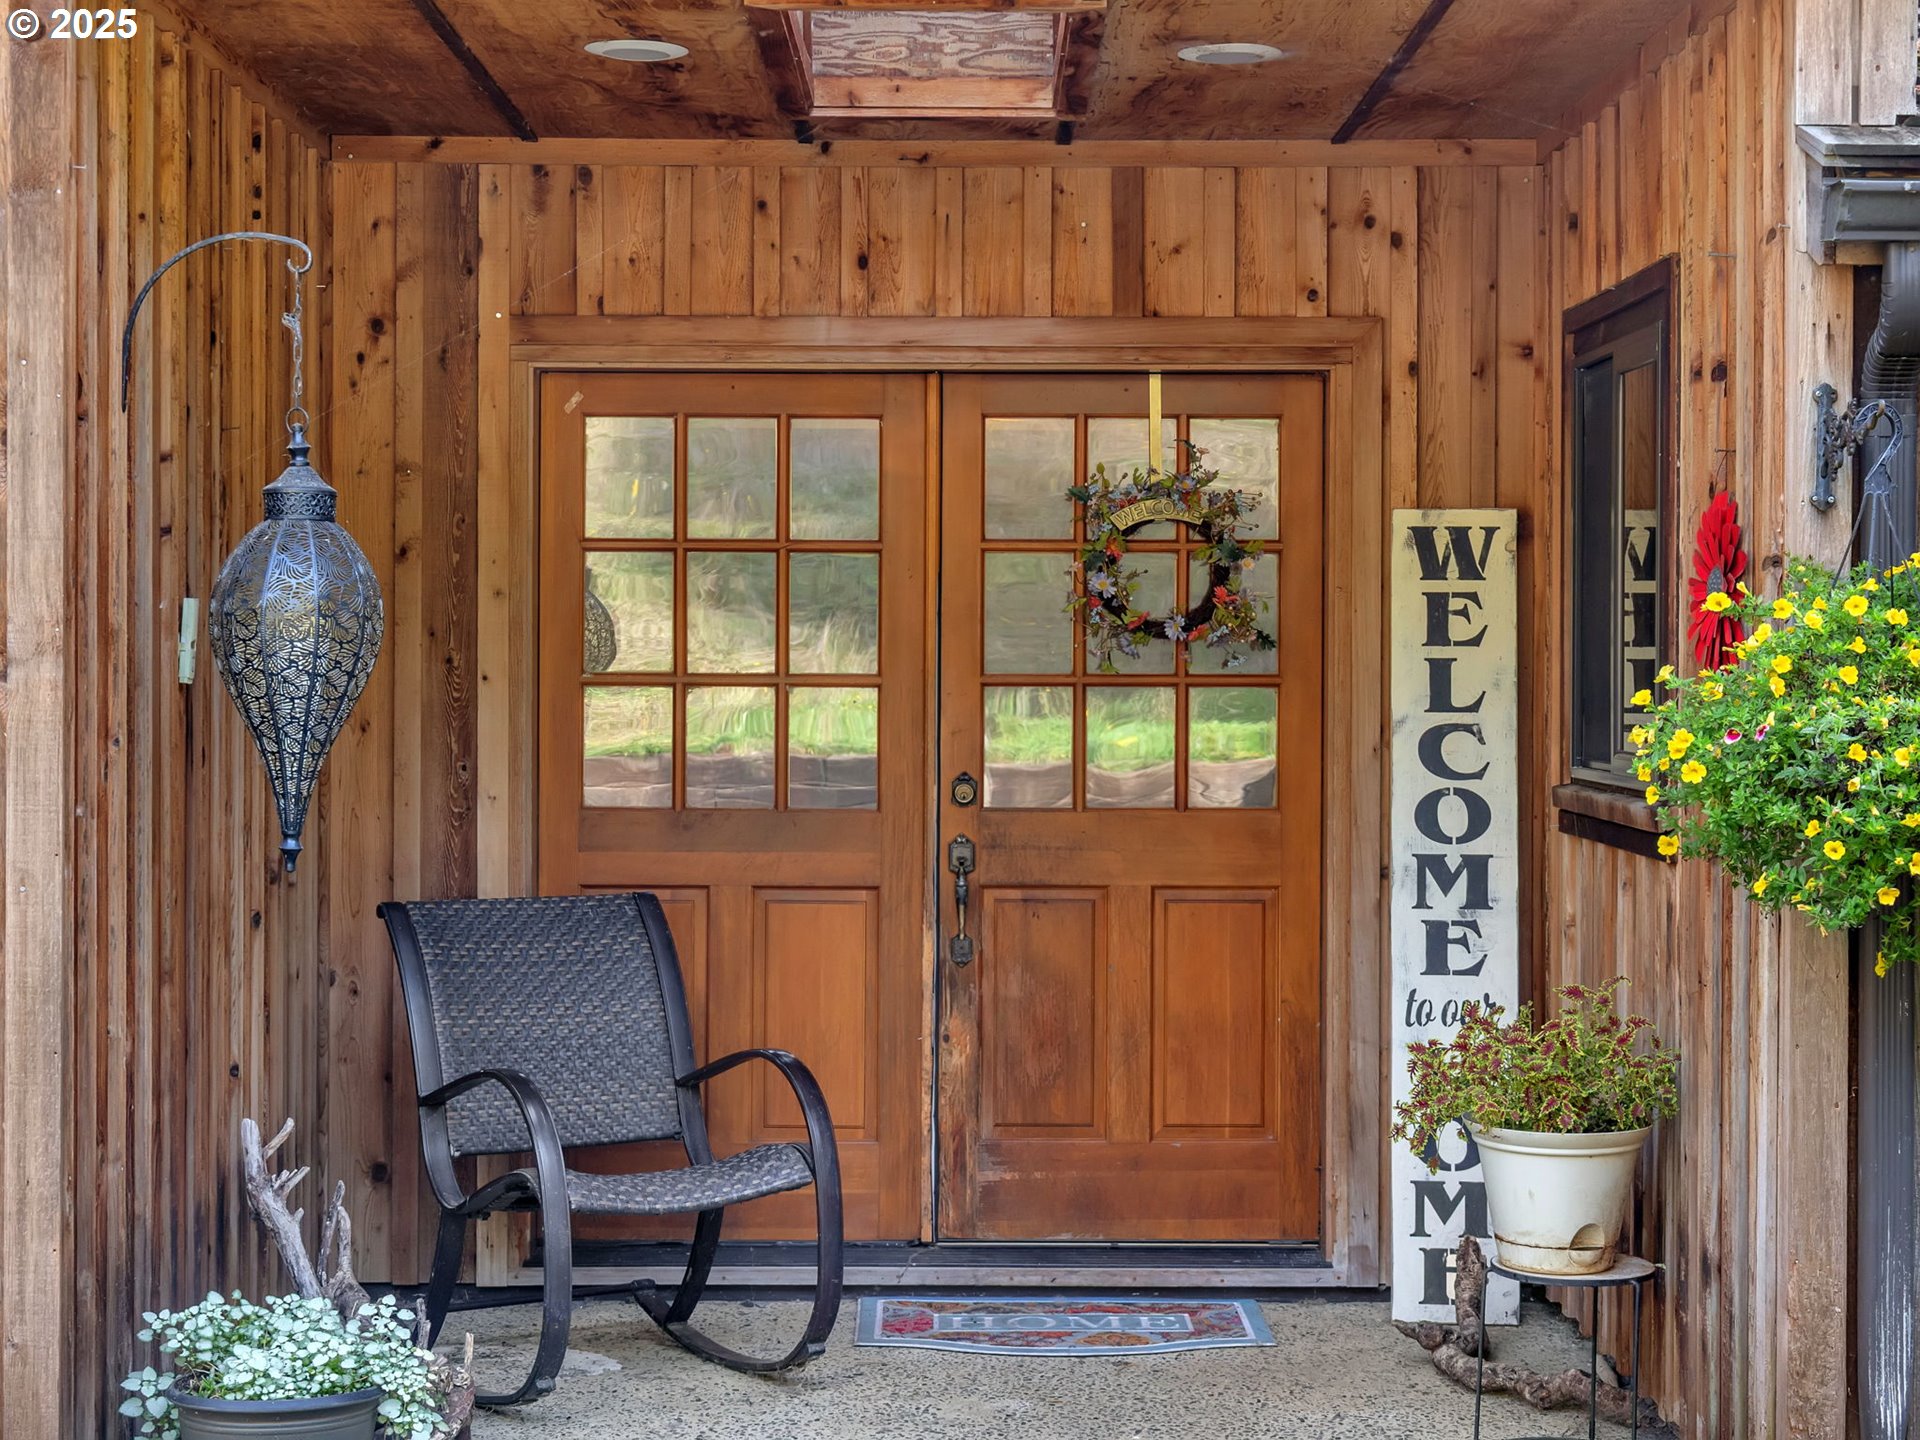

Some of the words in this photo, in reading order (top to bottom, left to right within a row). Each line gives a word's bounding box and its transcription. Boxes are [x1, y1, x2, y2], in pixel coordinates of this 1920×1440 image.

[1407, 526, 1500, 977] WELCOME
[1405, 988, 1436, 1027] to
[1410, 1047, 1492, 1305] OME
[952, 1316, 1180, 1329] HOME
